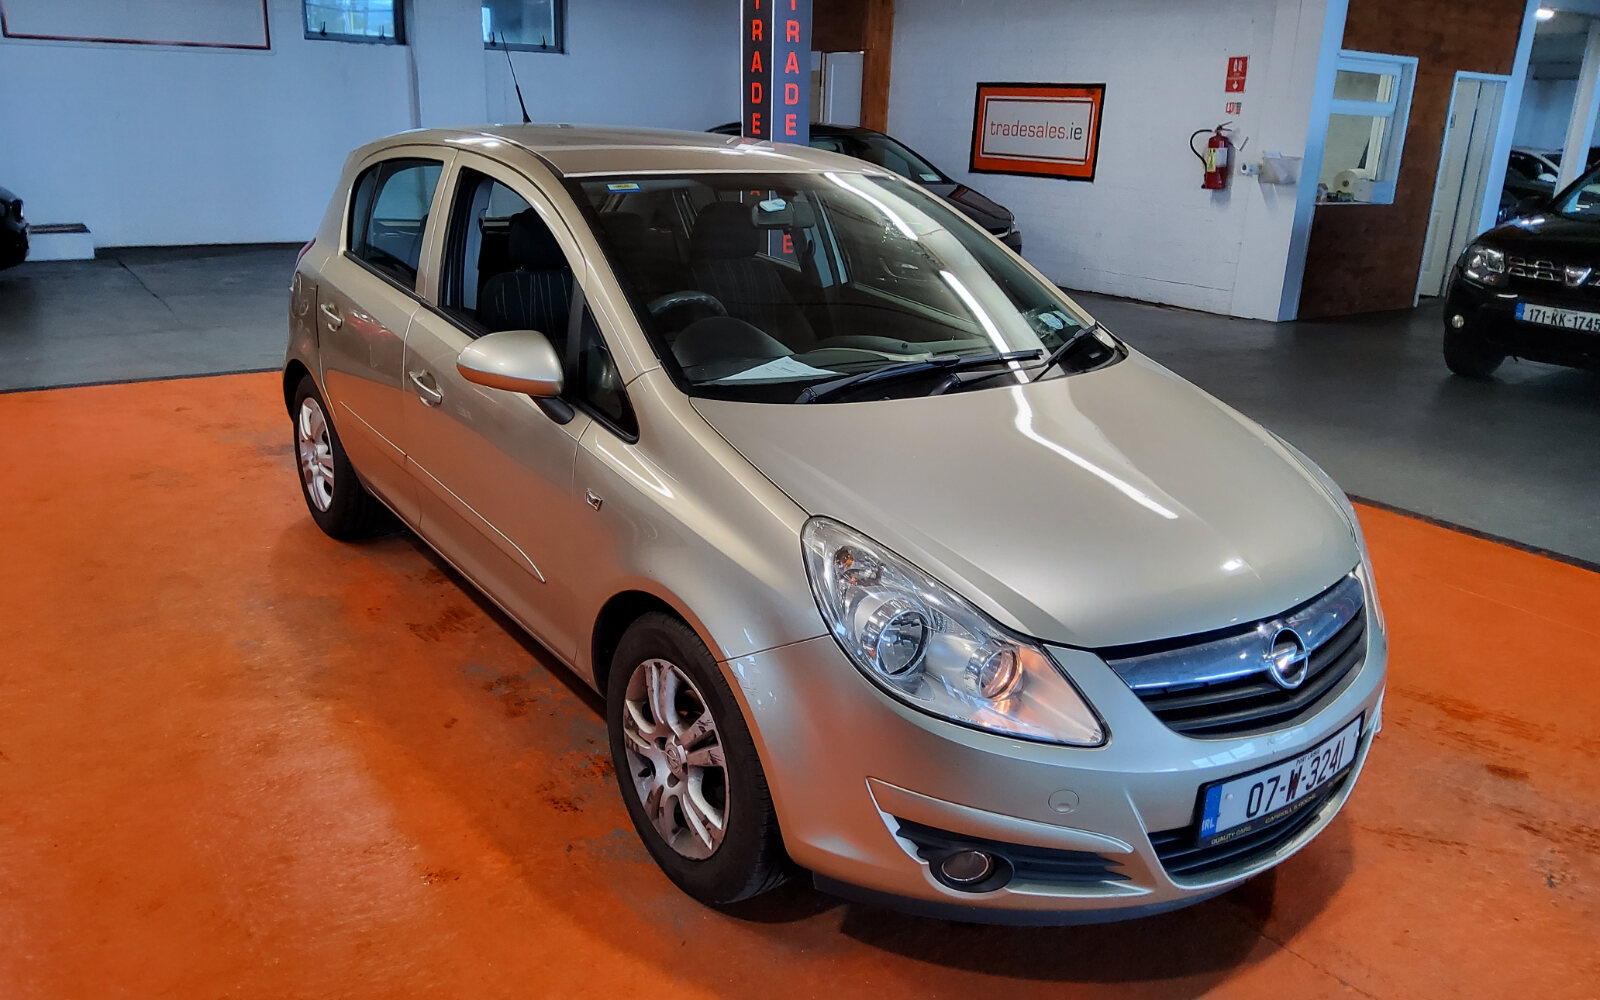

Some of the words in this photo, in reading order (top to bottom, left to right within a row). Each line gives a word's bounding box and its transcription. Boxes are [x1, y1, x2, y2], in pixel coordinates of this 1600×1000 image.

[990, 120, 1083, 141] tradesales.ie
[1246, 736, 1346, 819] 07-W-3241
[1201, 817, 1216, 832] IRL
